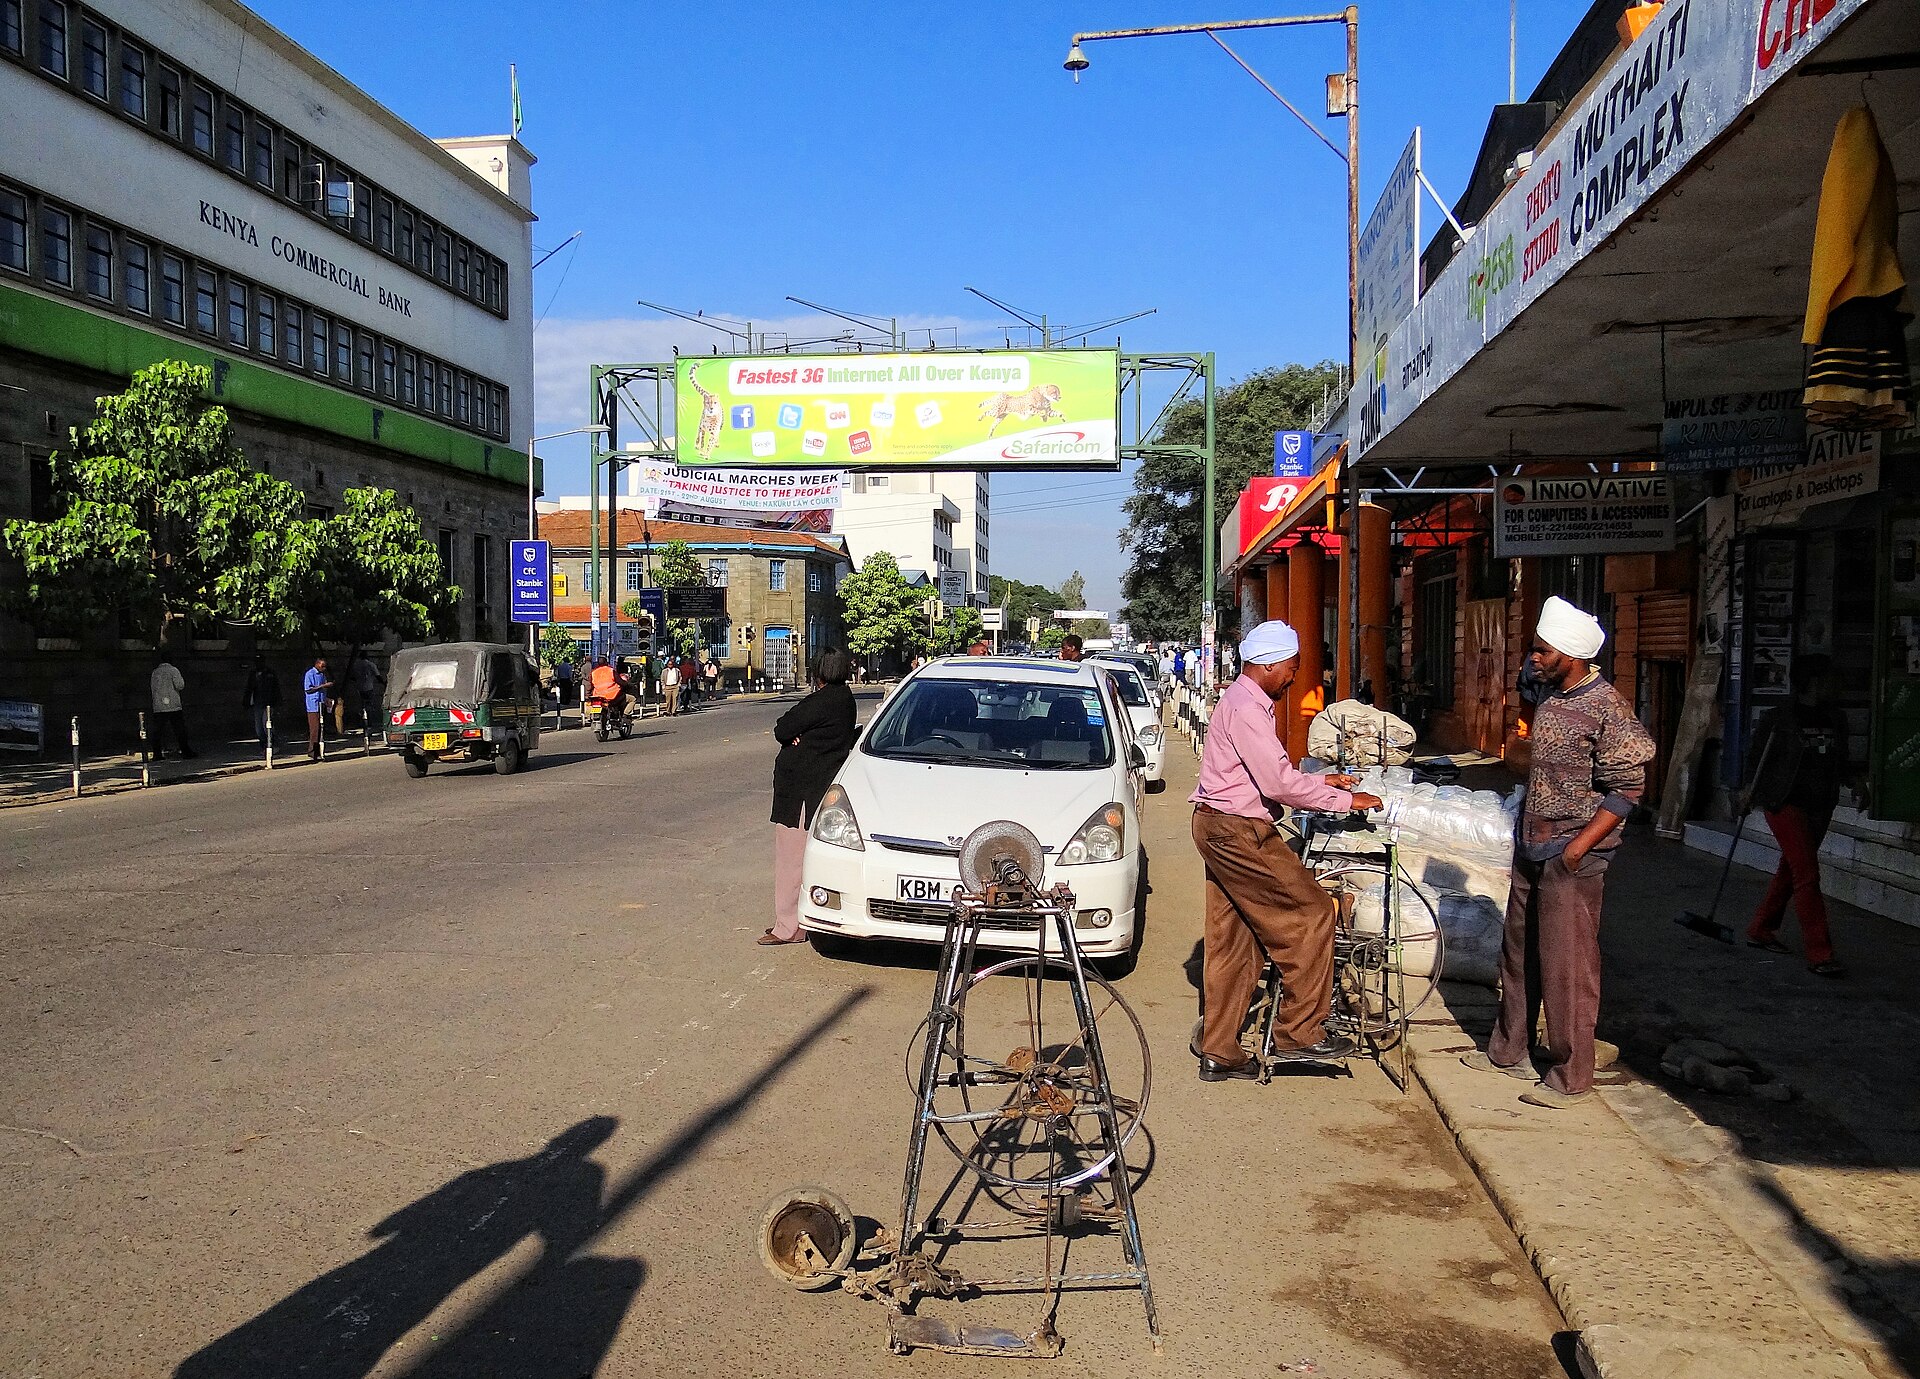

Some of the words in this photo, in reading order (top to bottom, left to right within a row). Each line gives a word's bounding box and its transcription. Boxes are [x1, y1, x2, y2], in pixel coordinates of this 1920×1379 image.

[1572, 0, 1691, 179] MUTHAITI
[1569, 77, 1690, 247] COMPLEX
[1526, 159, 1561, 232] PHOTO
[199, 200, 259, 248] KENYA
[271, 235, 370, 299] COMMERCIAL
[378, 286, 412, 318] BANK
[1522, 217, 1560, 286] STUDIO
[1402, 336, 1433, 390] amazing!
[737, 368, 798, 385] Fastest
[802, 367, 824, 384] 3G
[827, 366, 894, 383] Internet
[898, 365, 921, 382] All
[926, 365, 965, 382] Over
[969, 364, 1022, 384] Kenya
[829, 410, 847, 421] CNN
[1680, 416, 1787, 446] KINYOZI
[851, 441, 871, 452] NEWS
[1011, 438, 1101, 455] Safaricom
[663, 467, 725, 483] JUDICIAL
[729, 473, 795, 486] MARCHES
[799, 473, 840, 486] WEEK
[710, 485, 751, 497] JUSTICE
[755, 488, 769, 498] TO
[772, 488, 792, 498] THE
[1751, 488, 1793, 511] Laptops
[1796, 483, 1804, 500] &
[1807, 471, 1864, 498] Desktops
[700, 496, 727, 506] AUGUST
[738, 499, 762, 508] VENUE:
[762, 499, 792, 508] NAKURU
[792, 499, 809, 507] LAW
[810, 497, 839, 507] COURTS
[1504, 508, 1524, 523] FOR
[1527, 506, 1588, 523] COMPUTERS
[1591, 507, 1599, 521] &
[1601, 503, 1671, 522] ACCESSORIES
[1504, 533, 1545, 542] MOBILE
[1505, 524, 1528, 534] TEL:
[522, 567, 537, 575] CfC
[516, 579, 544, 587] Stanbic
[520, 590, 540, 599] Bank
[900, 878, 941, 901] KBM
